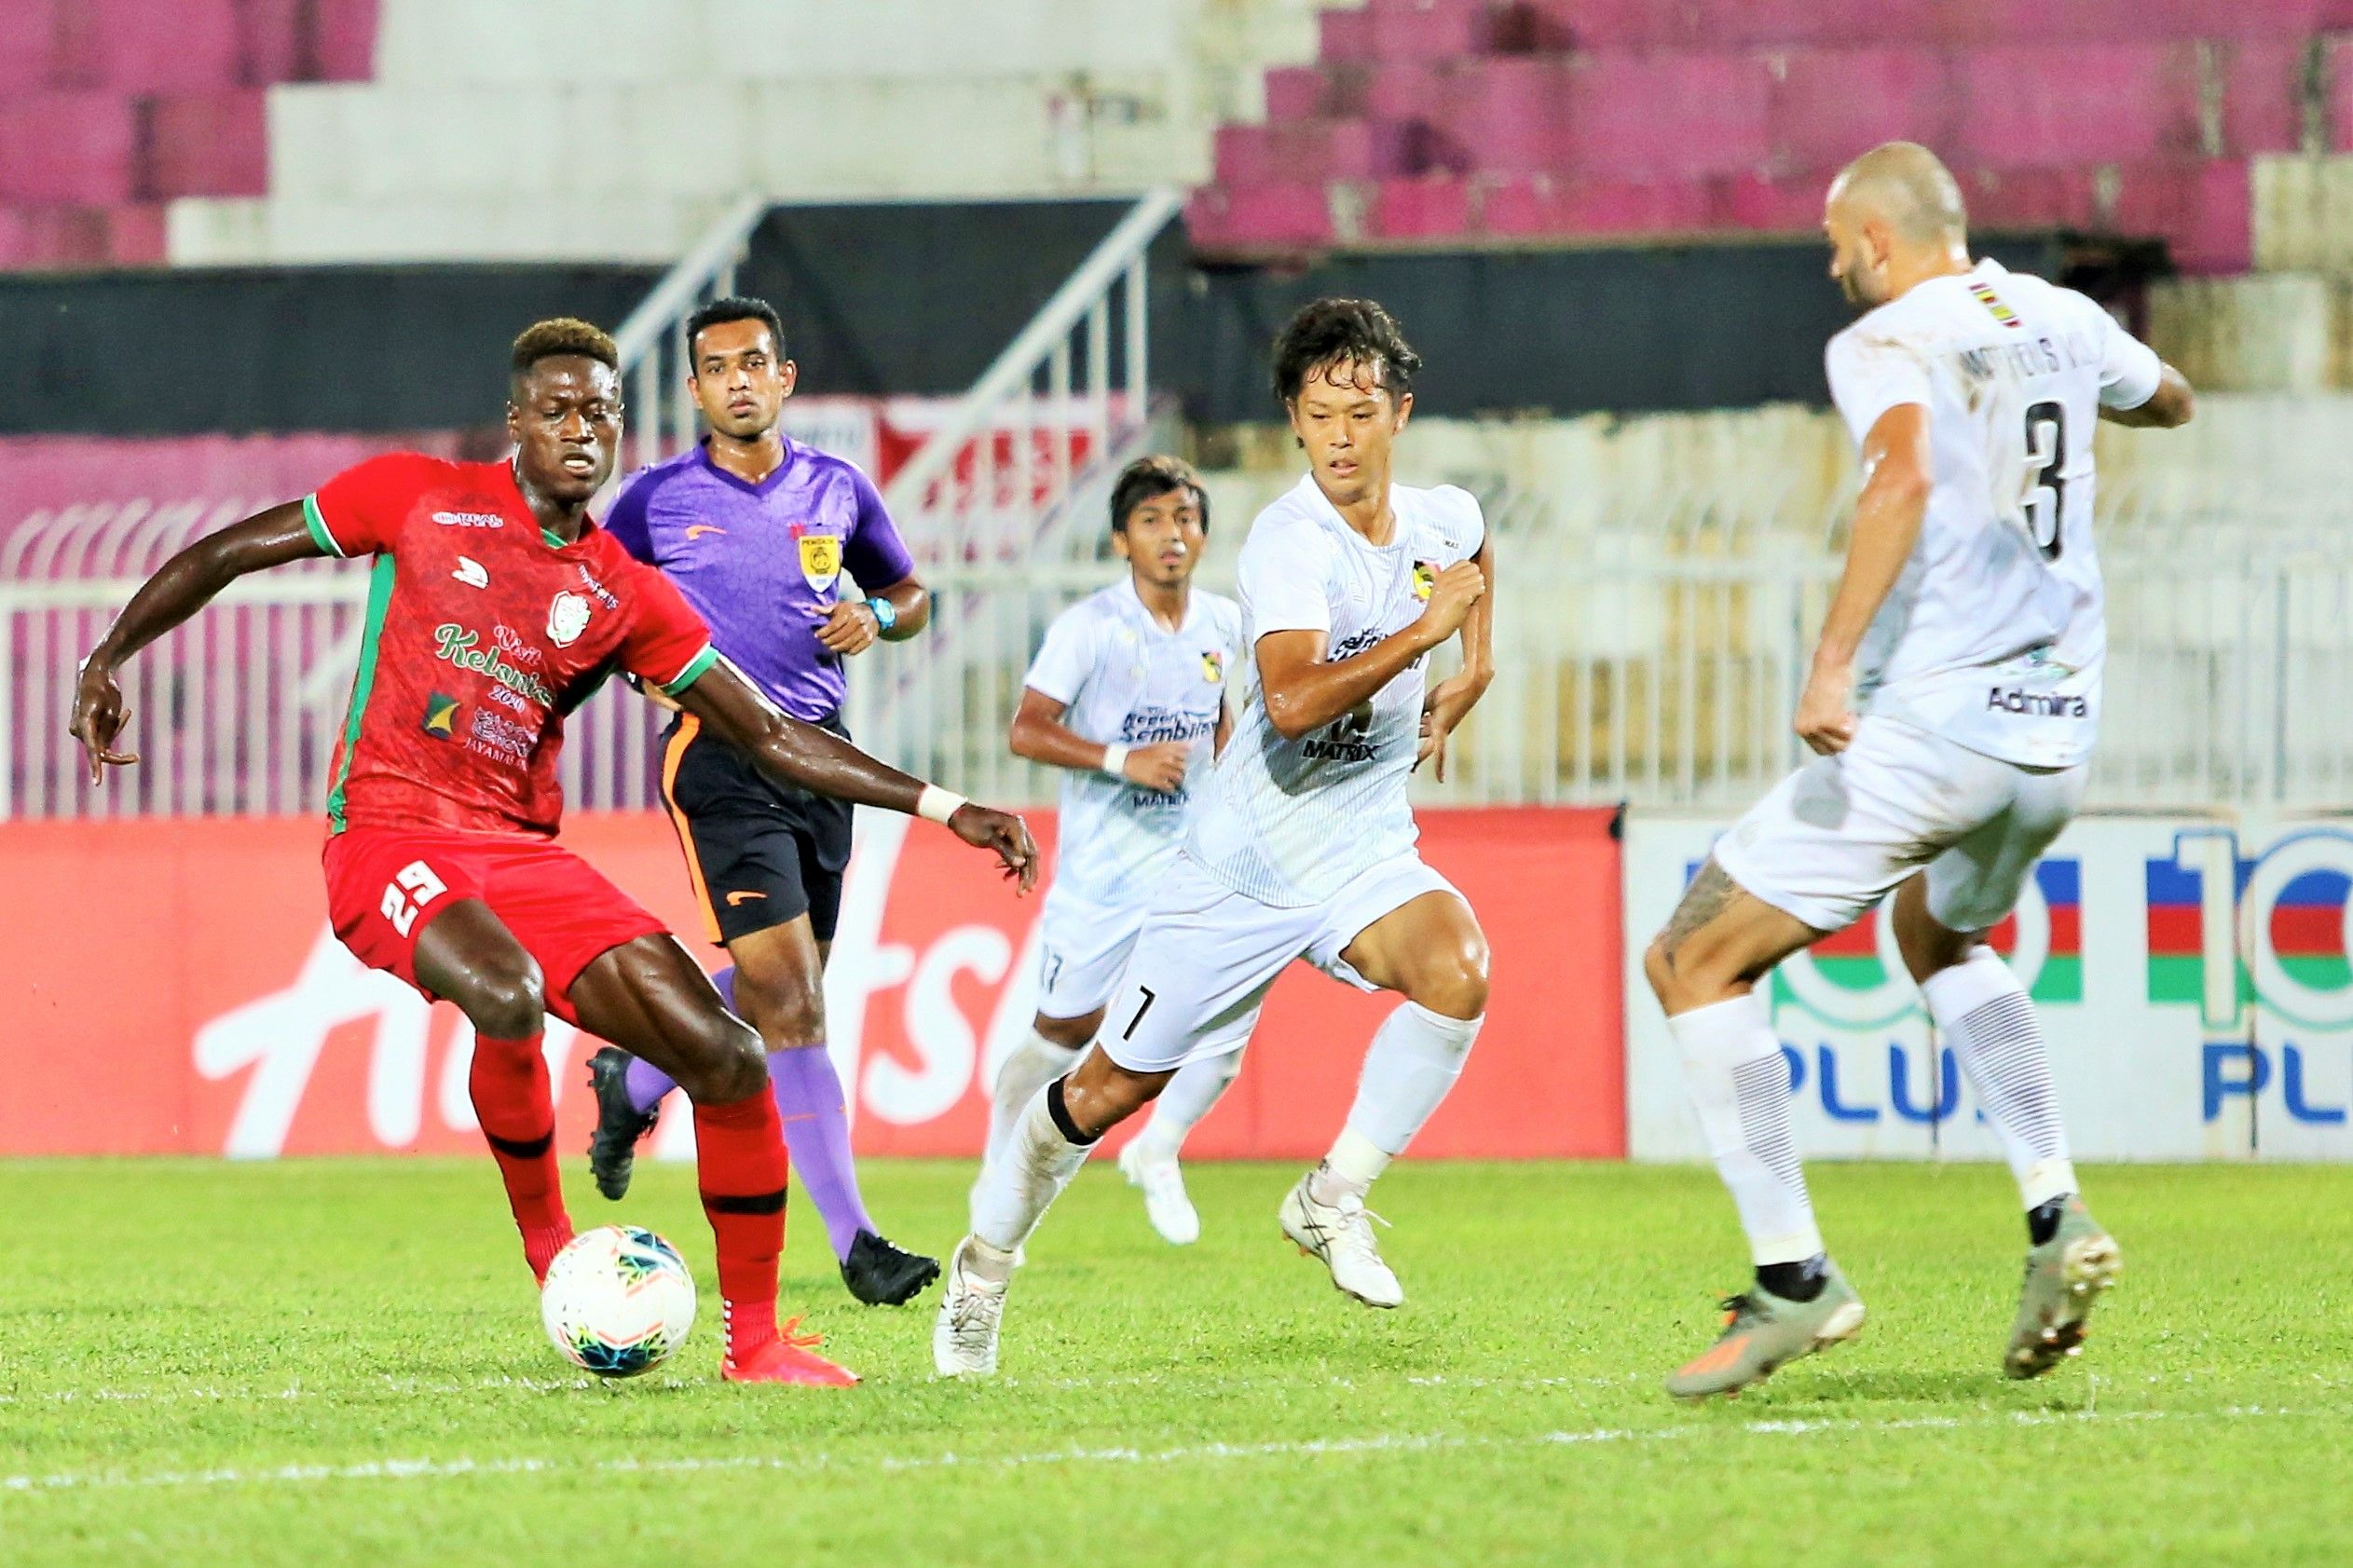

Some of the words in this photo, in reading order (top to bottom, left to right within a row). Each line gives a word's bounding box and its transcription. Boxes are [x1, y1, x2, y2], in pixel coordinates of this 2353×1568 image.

[2025, 401, 2065, 562] 3
[493, 624, 542, 666] Visit
[487, 684, 526, 714] 2020
[1988, 687, 2086, 717] Admira
[1303, 739, 1380, 761] MATRIX
[379, 859, 448, 939] 29
[1122, 984, 1156, 1042] 7
